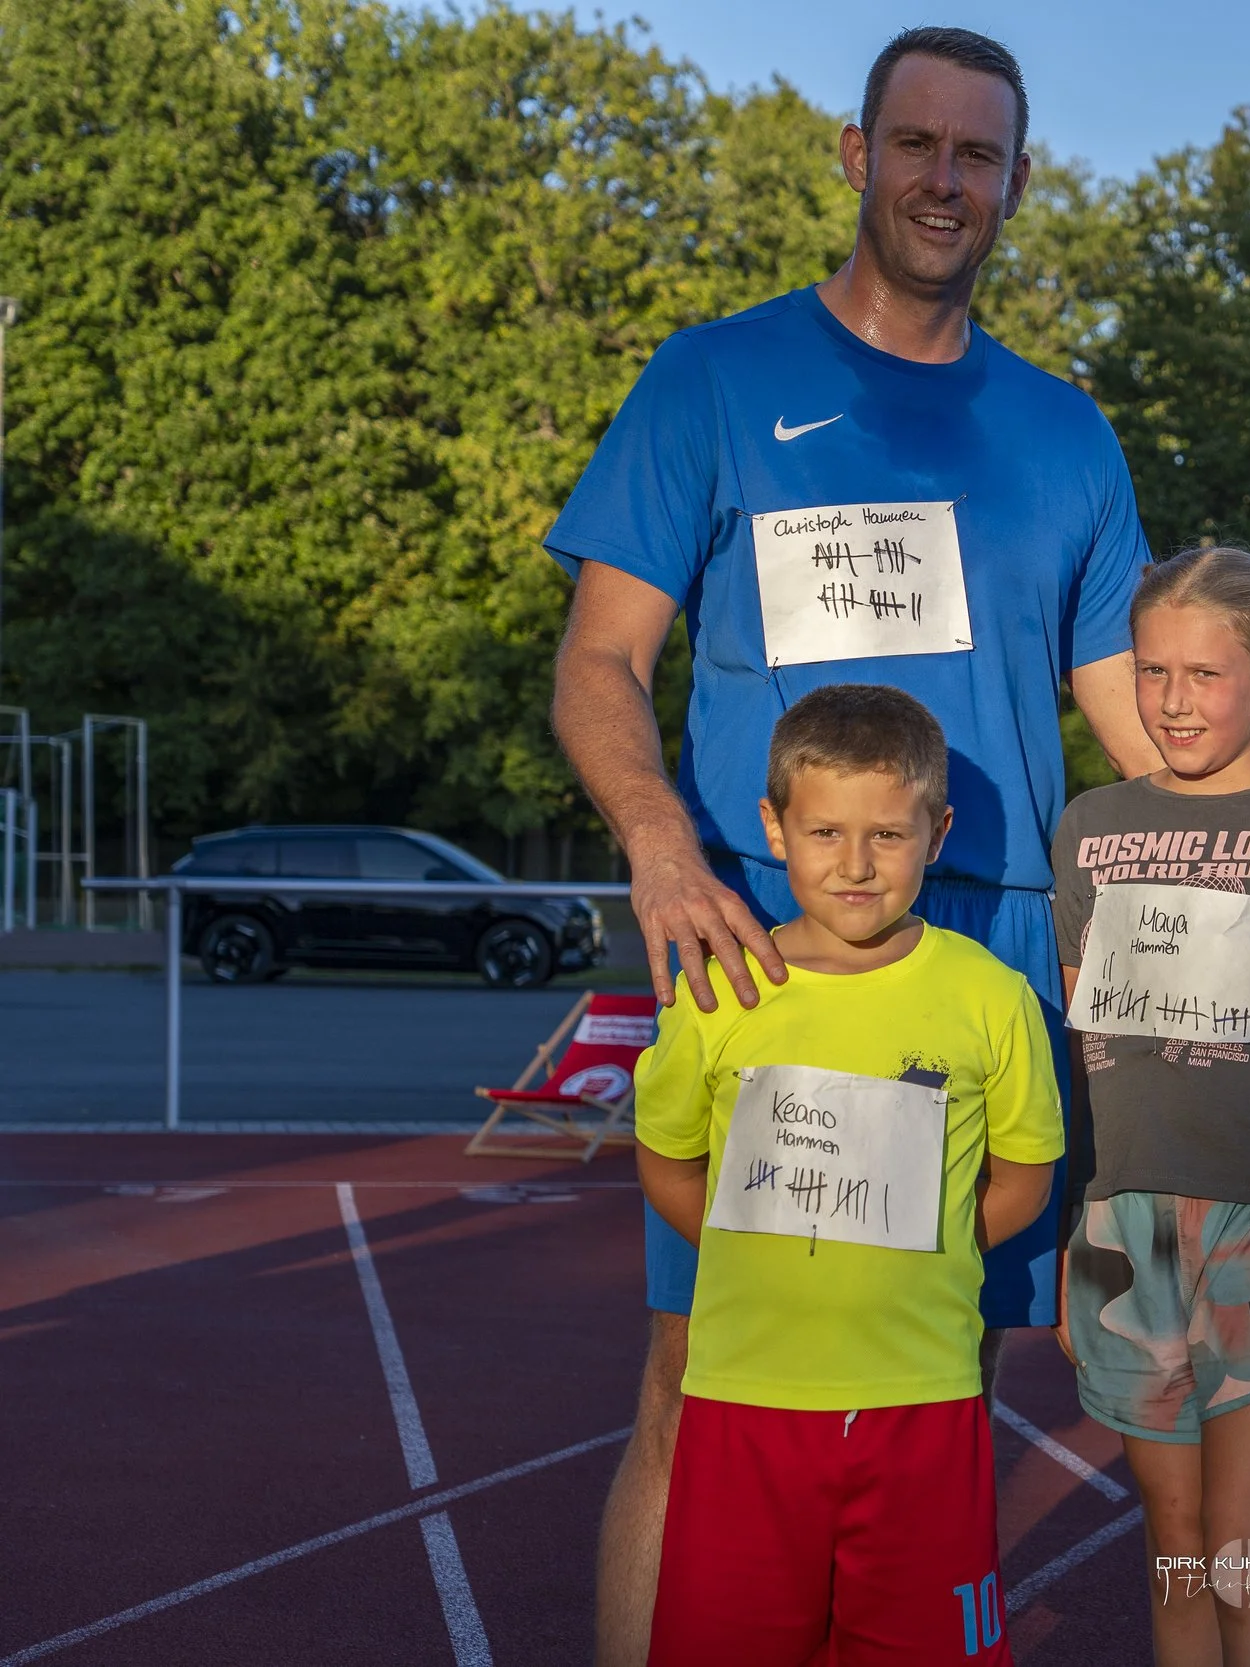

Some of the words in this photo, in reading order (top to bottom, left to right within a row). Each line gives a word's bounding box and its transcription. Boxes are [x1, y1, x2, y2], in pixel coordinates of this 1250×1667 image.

[774, 511, 852, 536] Christoph
[1077, 831, 1208, 868] COSMIC
[1092, 863, 1189, 887] WOLRD
[1138, 905, 1188, 944] Maya
[1130, 938, 1180, 955] Hammen
[1085, 1041, 1106, 1053] BOSTON
[1190, 1047, 1207, 1057] SAN
[1207, 1049, 1249, 1062] FRANCISCO
[1187, 1057, 1212, 1068] MIAMI
[773, 1091, 836, 1128] Keano
[776, 1128, 840, 1155] Hammen
[953, 1571, 1001, 1656] 10
